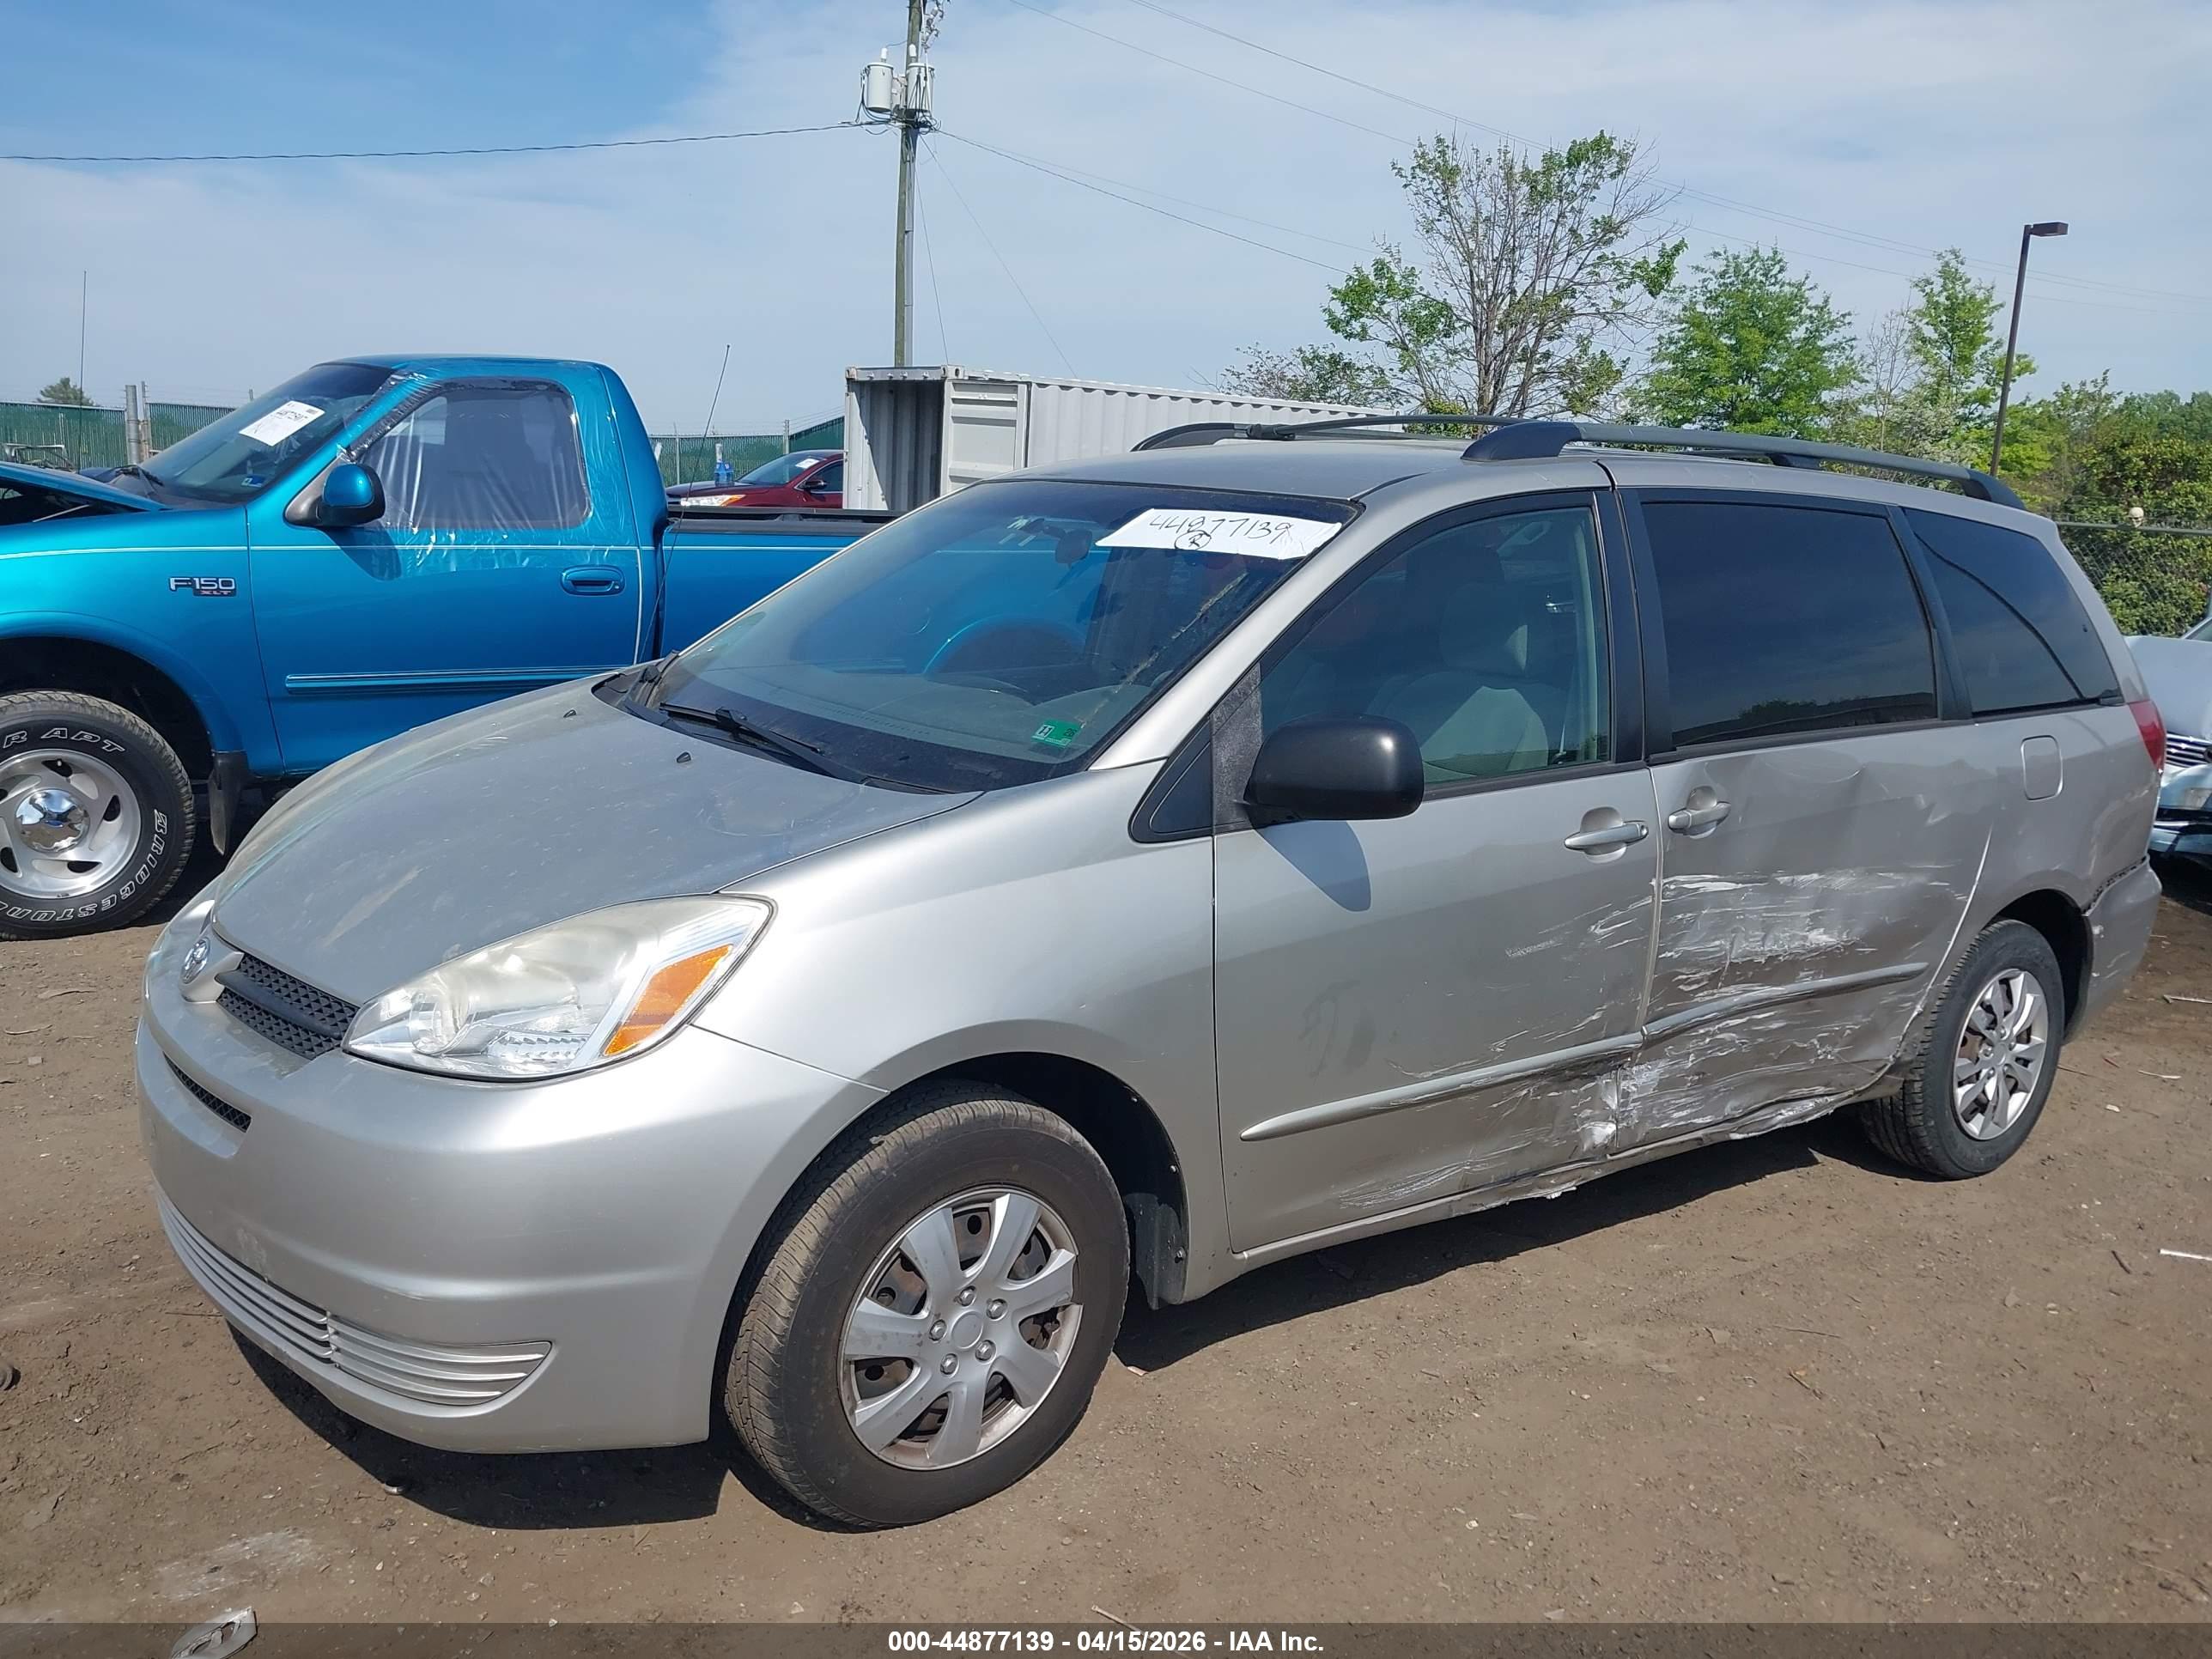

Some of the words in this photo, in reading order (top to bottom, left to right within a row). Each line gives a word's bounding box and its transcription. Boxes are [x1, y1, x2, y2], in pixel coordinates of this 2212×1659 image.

[1149, 515, 1294, 544] 44877139
[41, 727, 125, 752] APT
[1038, 726, 1053, 736] 11
